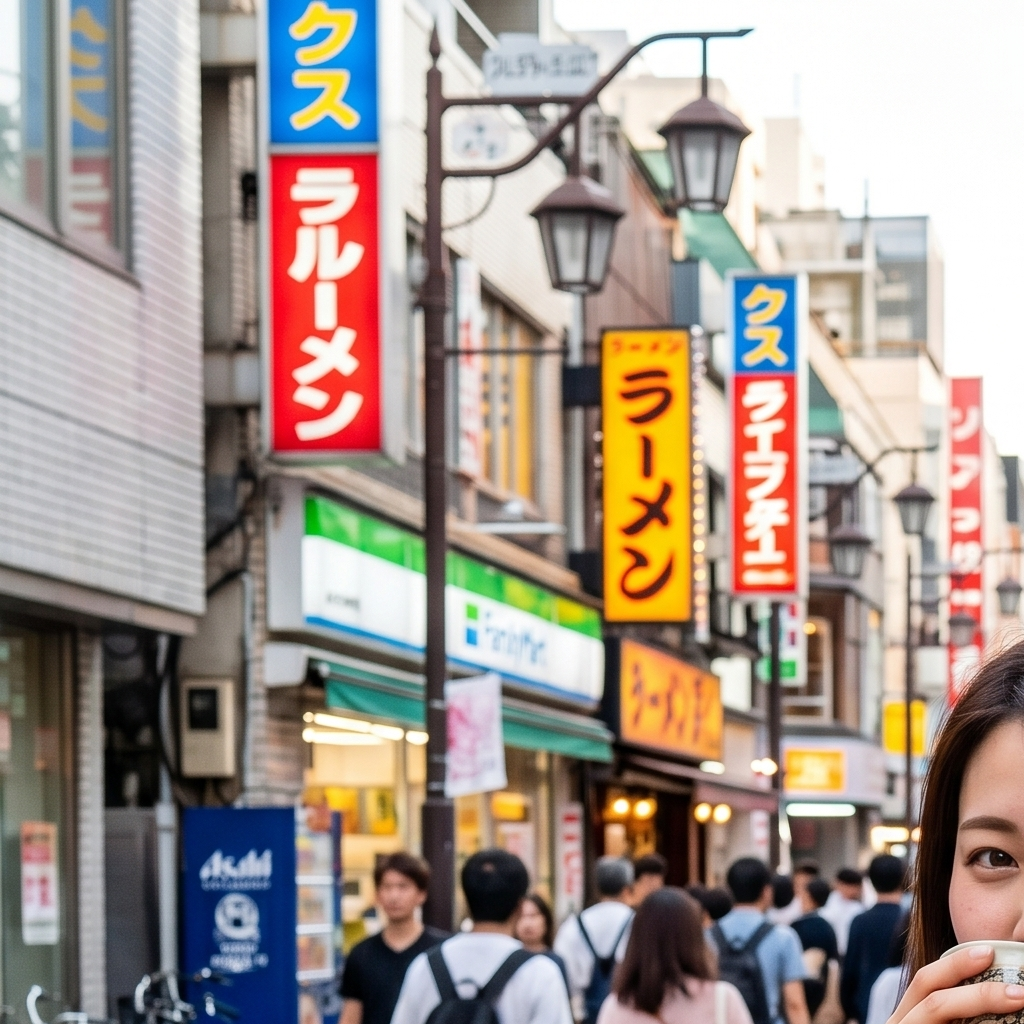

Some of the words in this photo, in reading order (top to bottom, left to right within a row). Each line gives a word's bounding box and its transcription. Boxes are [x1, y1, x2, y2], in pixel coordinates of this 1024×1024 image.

[289, 2, 361, 130] クス
[288, 167, 364, 442] ラルーメン
[742, 283, 789, 367] クス
[620, 369, 673, 601] ラーメン
